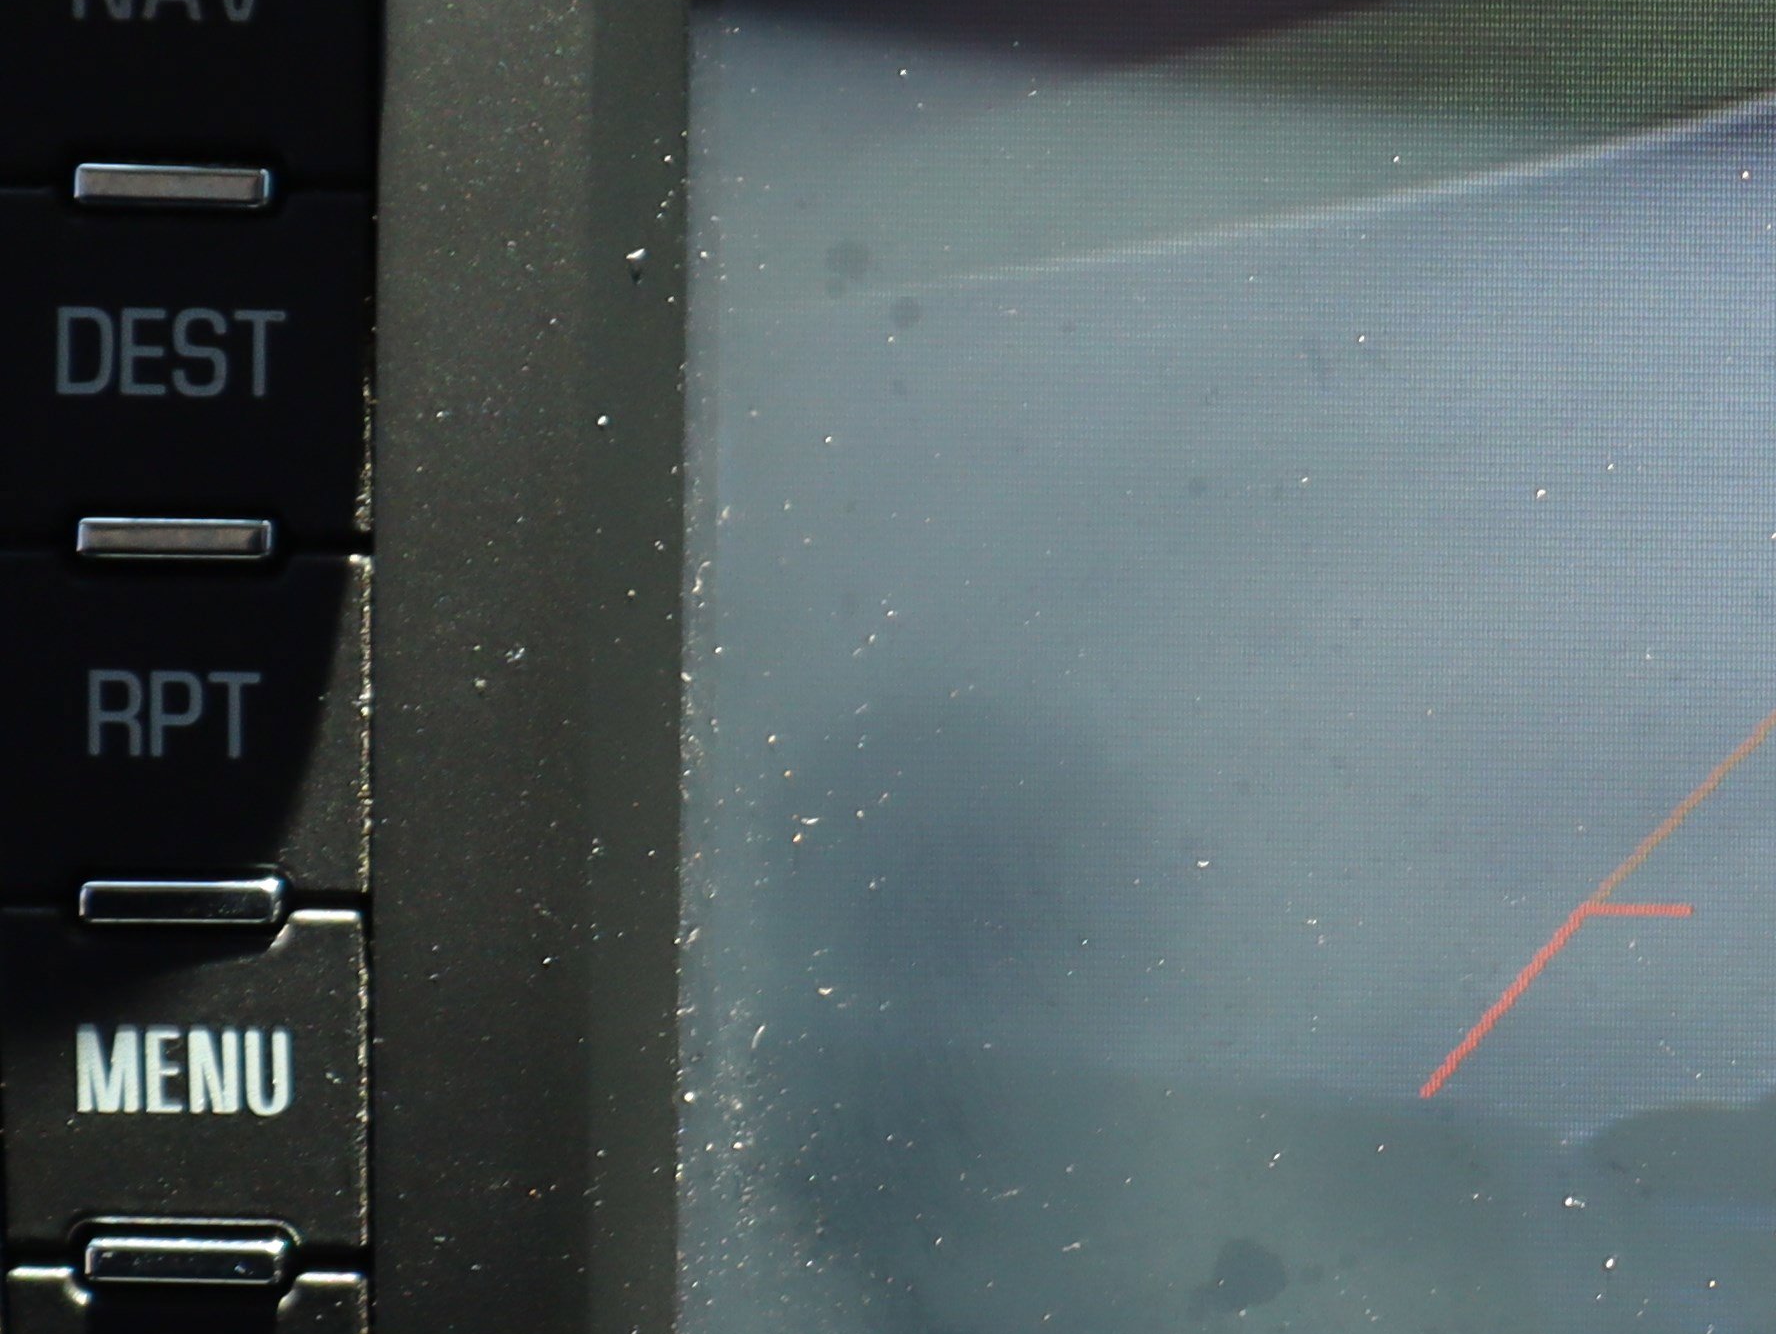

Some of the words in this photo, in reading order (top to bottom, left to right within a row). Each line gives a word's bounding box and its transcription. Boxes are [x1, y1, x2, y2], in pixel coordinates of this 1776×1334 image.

[55, 305, 288, 398] DEST
[87, 669, 262, 760] RPT
[75, 1021, 294, 1117] MENU
